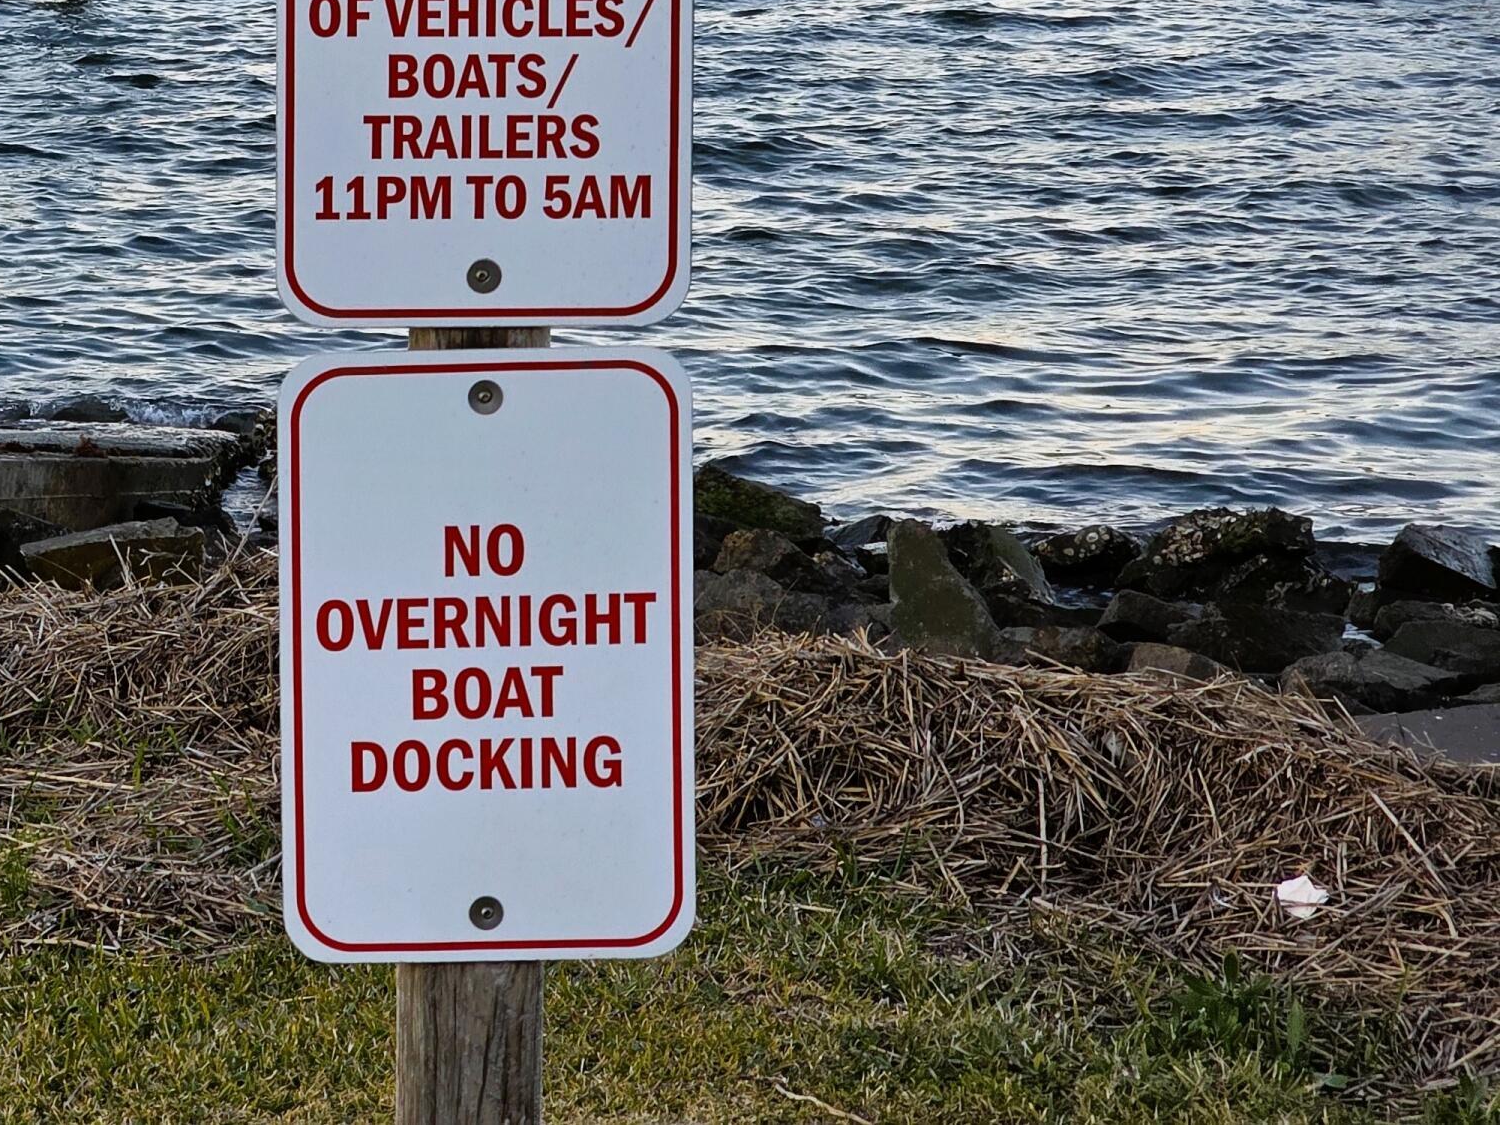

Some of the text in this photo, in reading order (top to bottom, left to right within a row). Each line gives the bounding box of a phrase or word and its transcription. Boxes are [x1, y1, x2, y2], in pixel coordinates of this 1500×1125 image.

[388, 53, 579, 109] BOATS/
[365, 114, 599, 159] TRAILERS
[317, 175, 651, 219] 11PM TO 5AM
[445, 524, 524, 576] NO
[316, 592, 656, 651] OVERNIGHT
[412, 667, 563, 720] BOAT
[351, 736, 622, 792] DOCKING
